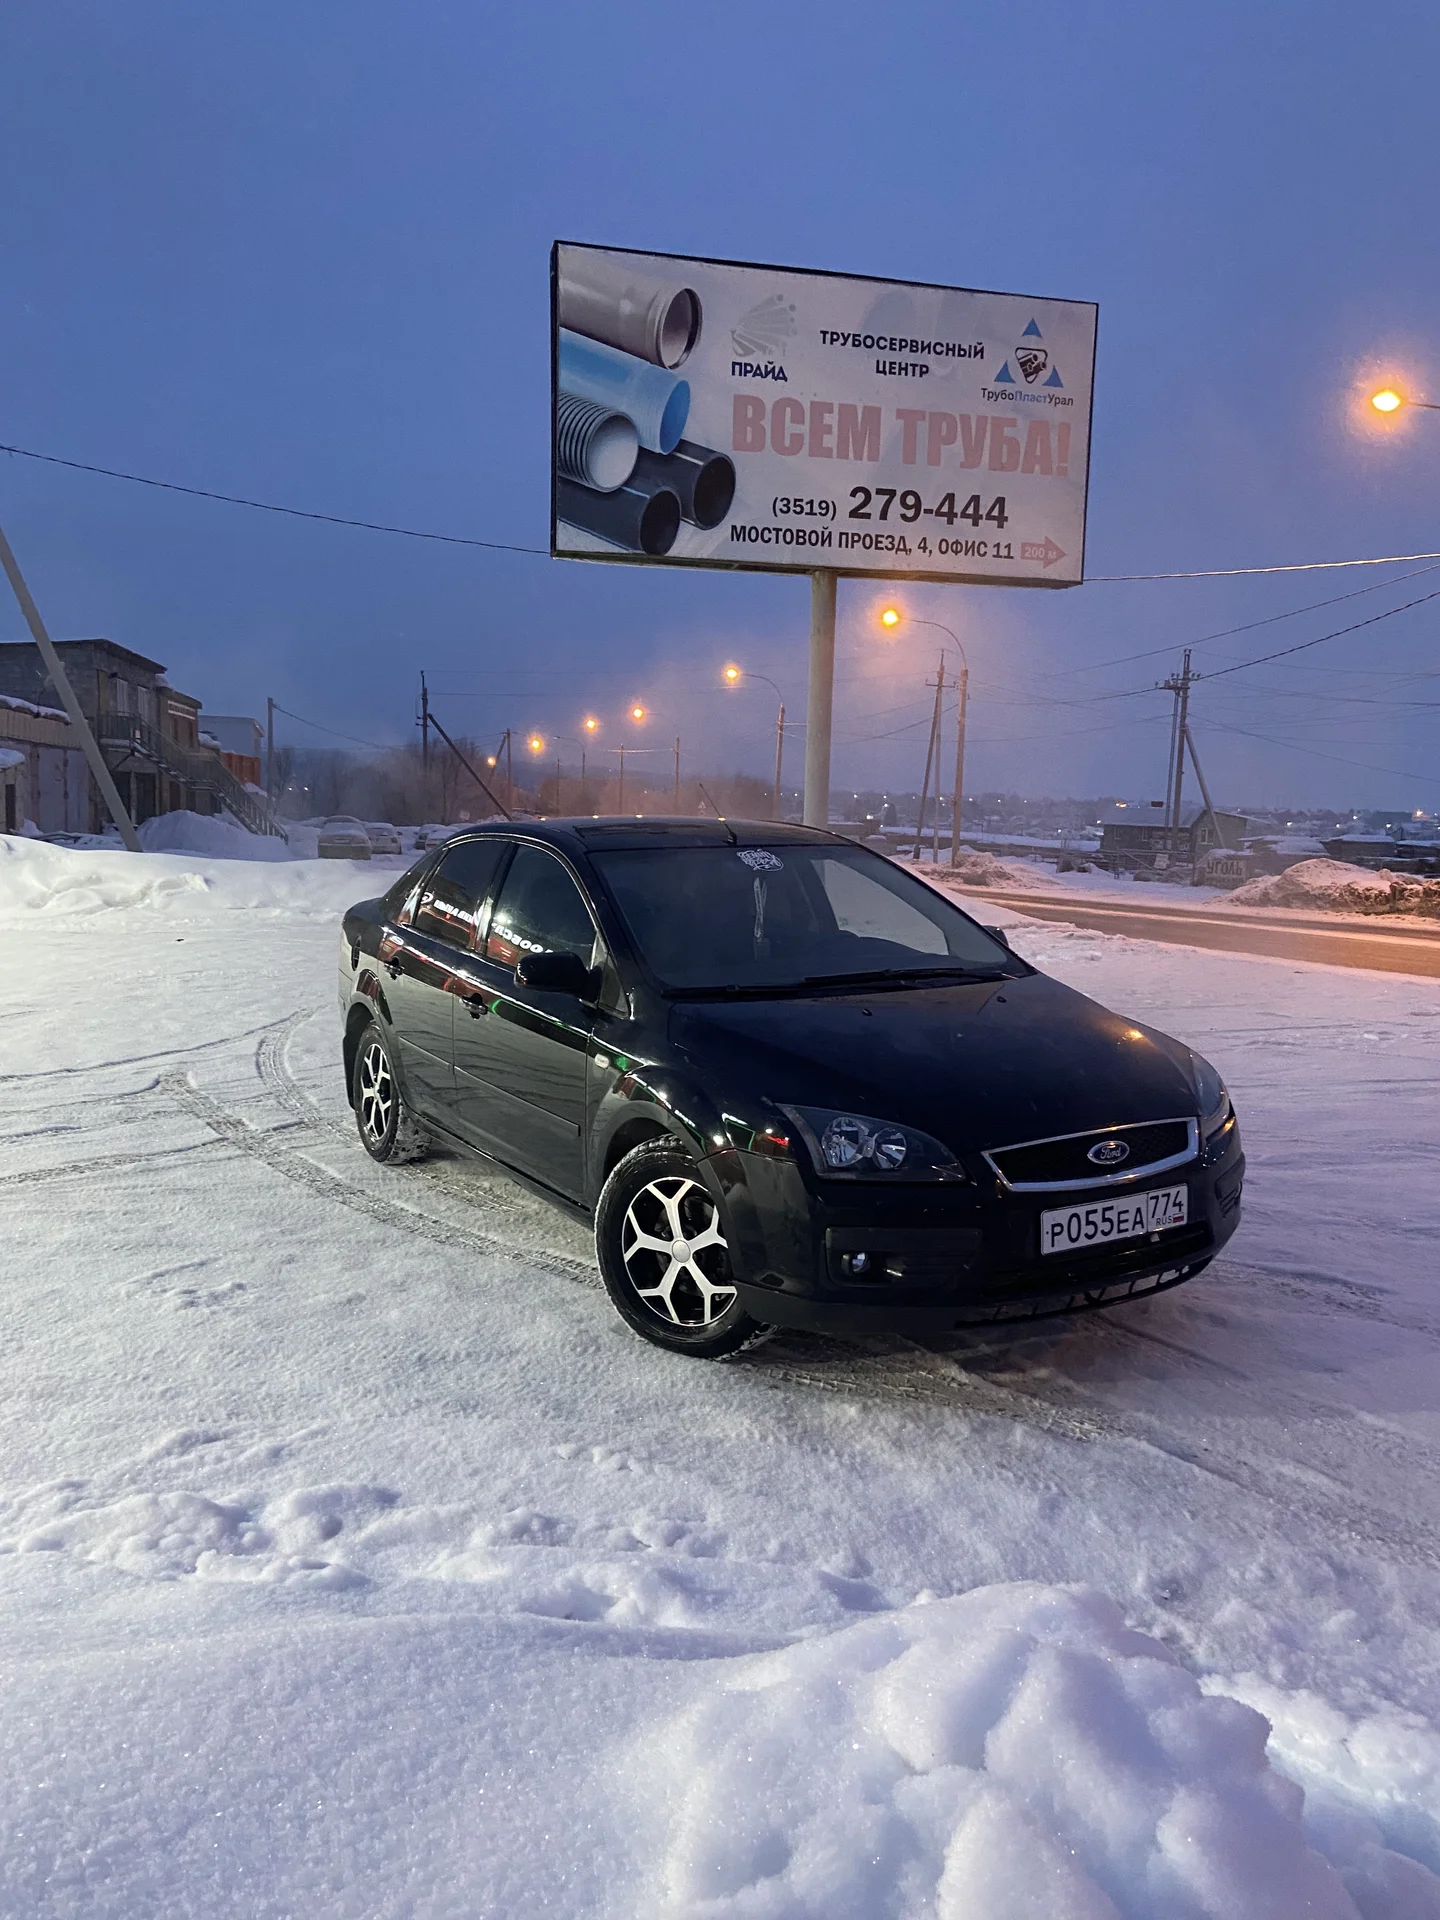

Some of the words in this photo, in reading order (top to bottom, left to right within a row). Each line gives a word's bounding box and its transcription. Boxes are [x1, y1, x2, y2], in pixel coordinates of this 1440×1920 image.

[820, 330, 985, 359] ТРУБОСЕРВИСНЫЙ
[731, 361, 788, 382] ПРАЙД
[875, 359, 930, 378] ЦЕНТР
[981, 387, 1074, 406] ТрубоПластУрал
[732, 394, 882, 462] ВСЕМ
[896, 408, 1071, 476] ТРУБА!
[772, 497, 837, 521] (3519)
[849, 486, 1008, 529] 279-444
[730, 524, 832, 548] МОСТОВОЙ
[838, 532, 912, 555] ПРОЕЗД,
[917, 537, 933, 557] 4,
[938, 538, 988, 557] ОФИС
[992, 542, 1014, 559] 11
[1024, 546, 1045, 559] 200
[1206, 860, 1243, 876] УГОЛЬ
[1100, 1147, 1122, 1160] Ford
[1149, 1190, 1183, 1219] 774
[1156, 1218, 1174, 1227] RUS
